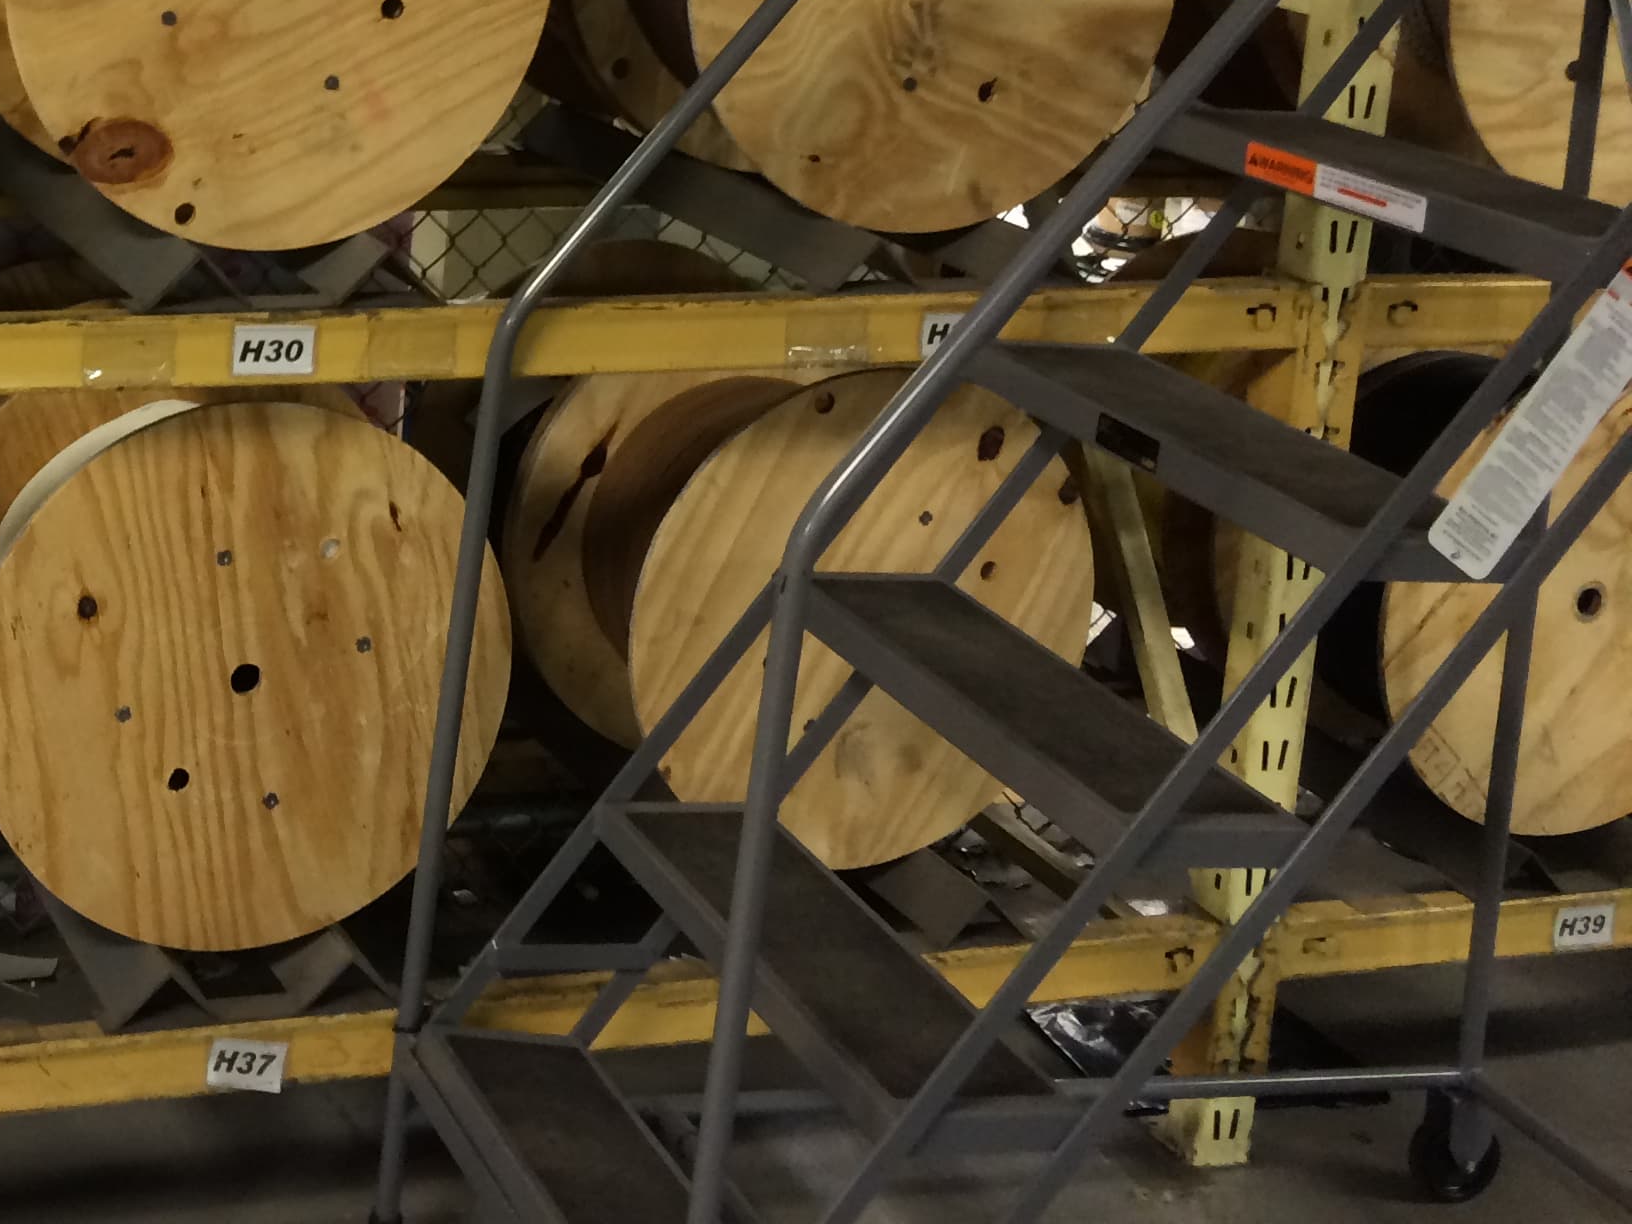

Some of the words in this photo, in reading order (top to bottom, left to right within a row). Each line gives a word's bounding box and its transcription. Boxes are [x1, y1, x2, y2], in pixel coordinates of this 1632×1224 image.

[238, 339, 304, 363] H30
[1558, 914, 1606, 937] H39
[213, 1049, 277, 1076] H37
